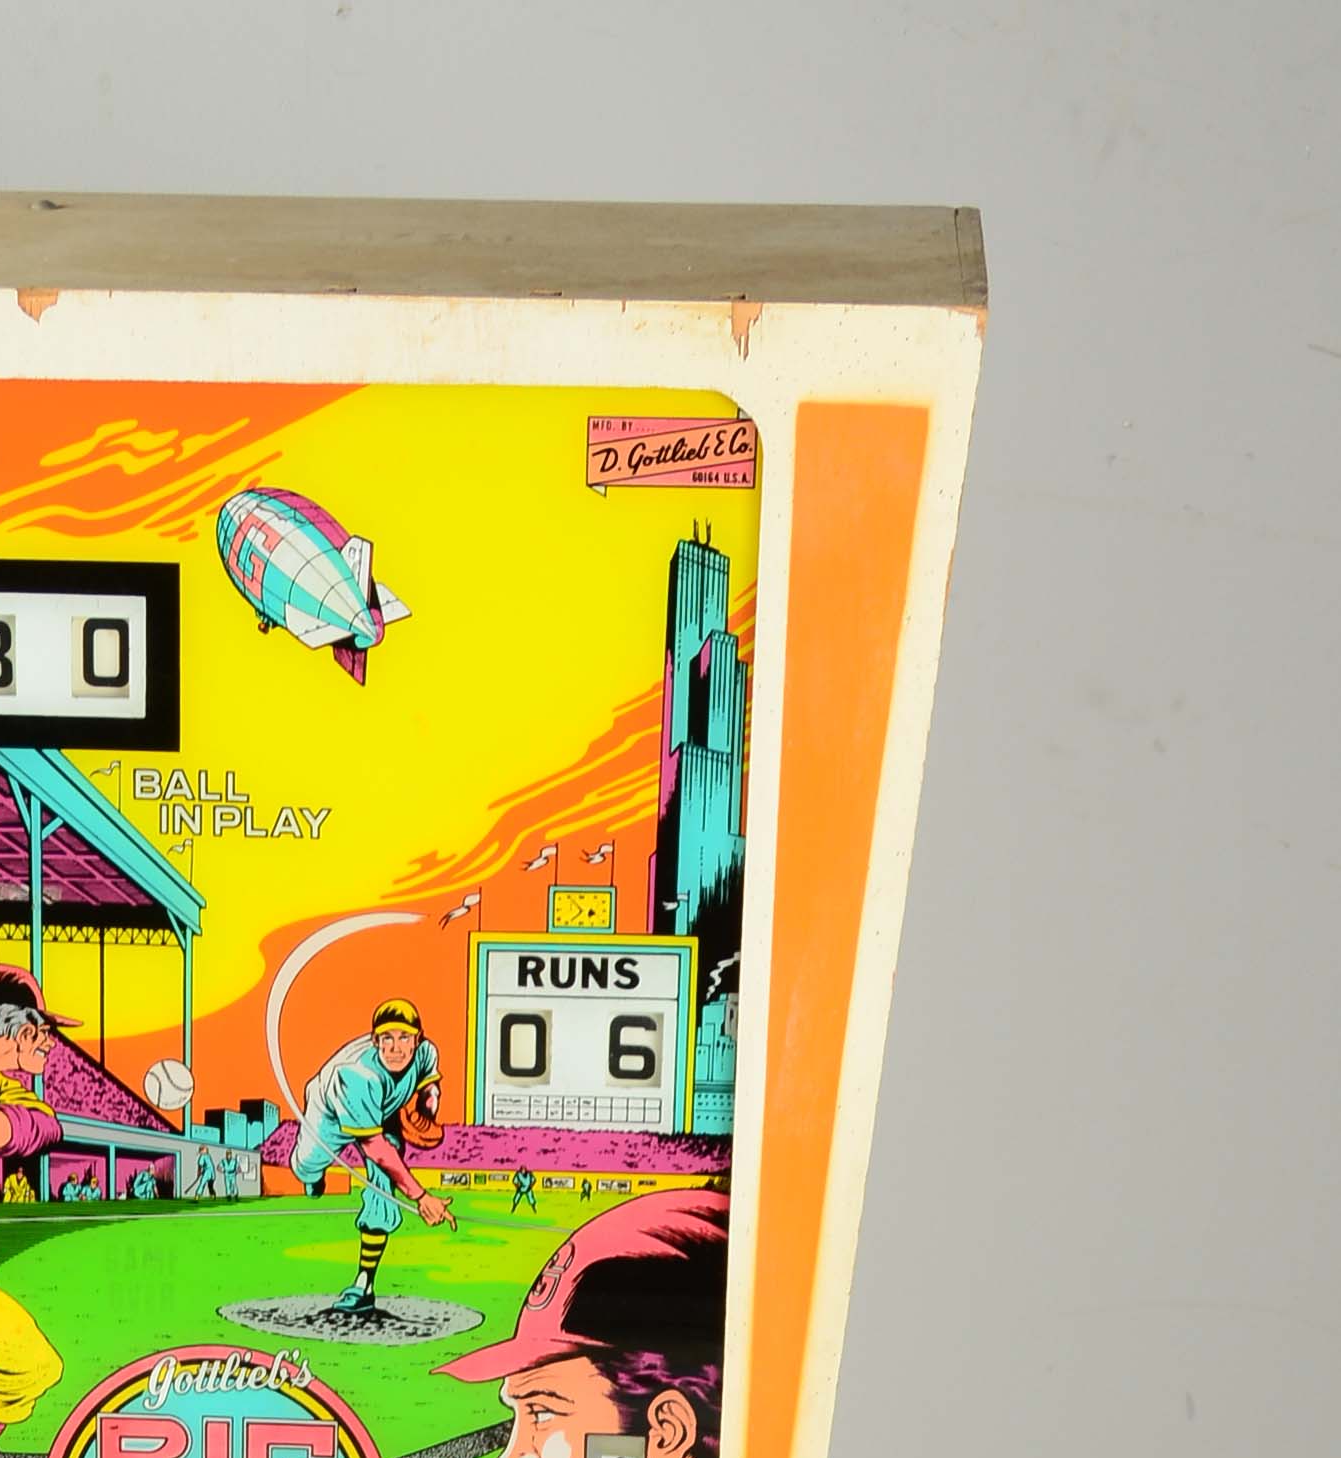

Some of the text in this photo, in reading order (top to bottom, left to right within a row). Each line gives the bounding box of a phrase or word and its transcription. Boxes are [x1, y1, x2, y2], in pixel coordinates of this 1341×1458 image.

[627, 432, 710, 475] Gottlieb
[729, 427, 753, 455] Co.
[132, 767, 250, 802] BALL
[159, 805, 332, 840] IN PLAY
[516, 955, 640, 991] RUNS
[143, 1349, 315, 1410] Gottlieb's
